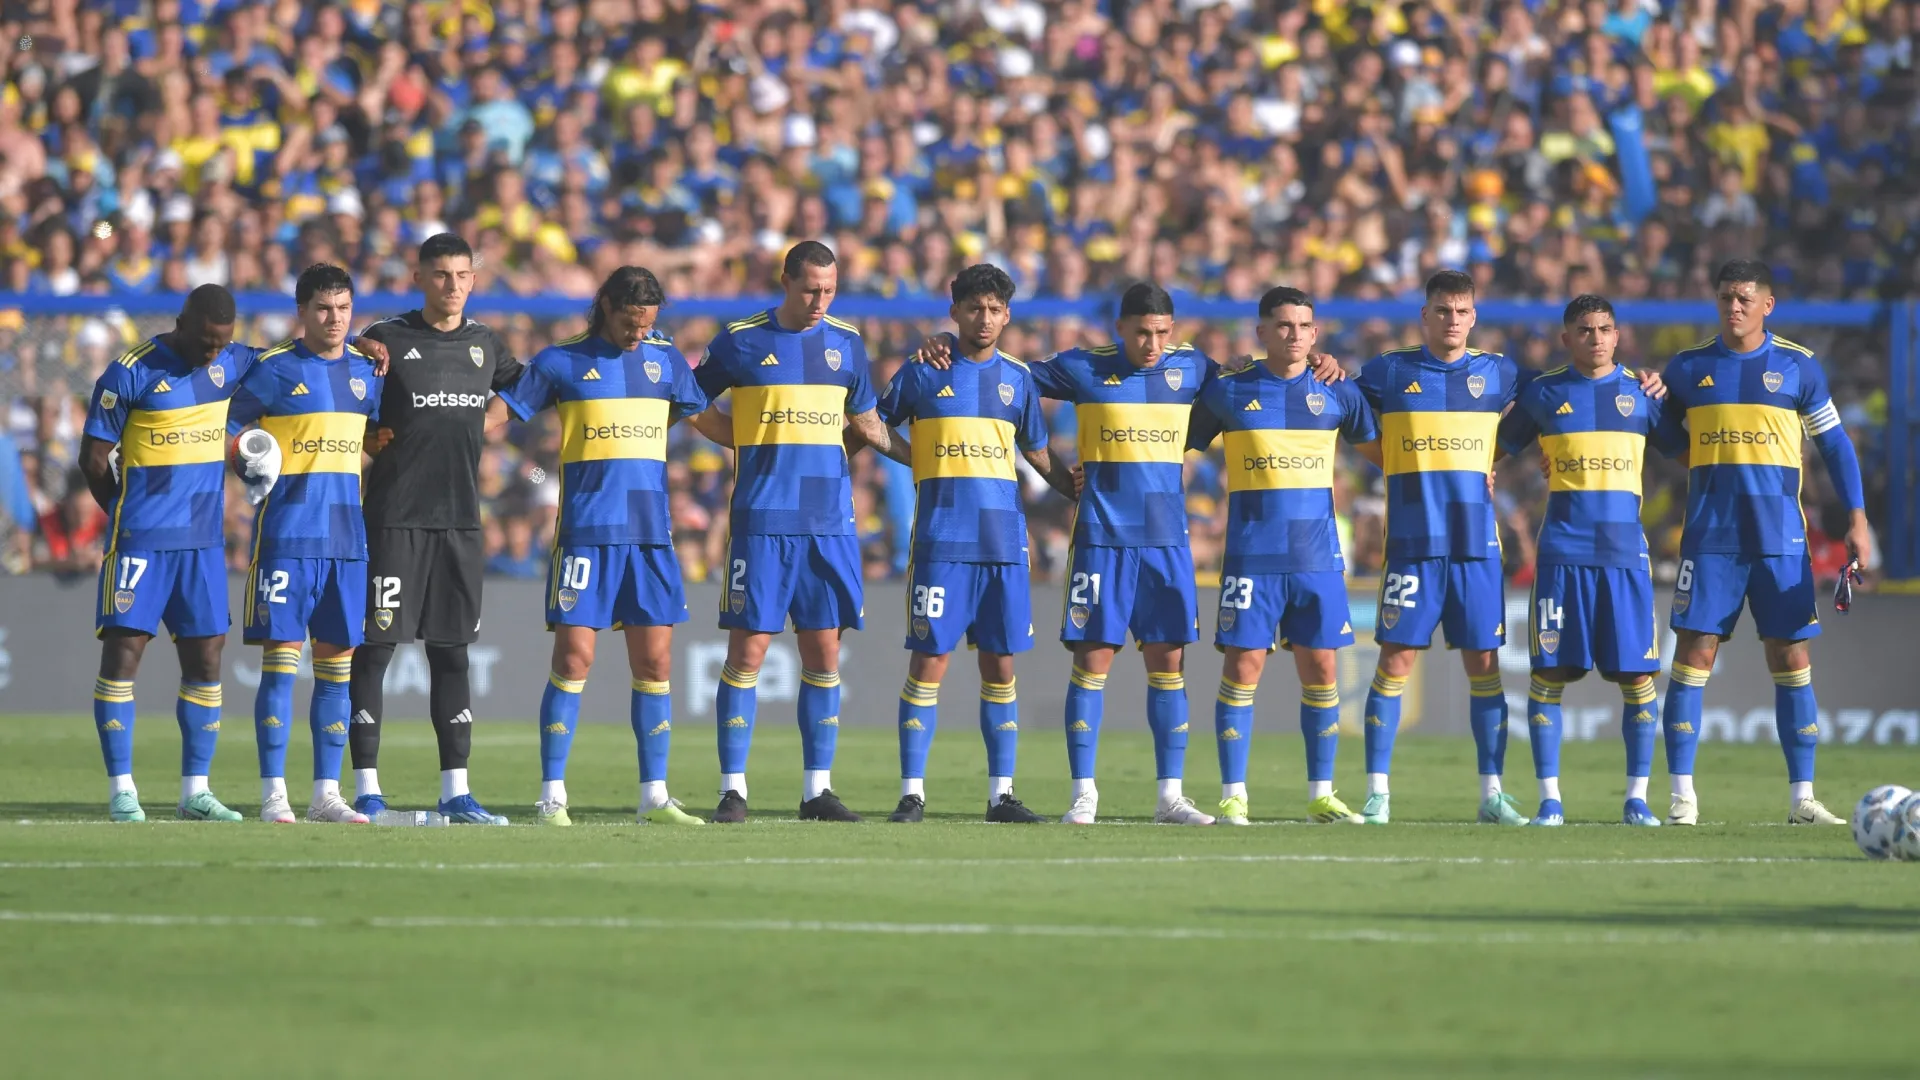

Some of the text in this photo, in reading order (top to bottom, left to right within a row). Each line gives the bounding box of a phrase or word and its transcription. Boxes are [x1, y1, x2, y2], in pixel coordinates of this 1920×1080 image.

[412, 390, 485, 408] betsson
[583, 422, 663, 440] betsson
[760, 407, 840, 427] betsson
[292, 436, 361, 454] betsson
[1100, 425, 1179, 443] betsson
[1401, 435, 1484, 452] betsson
[1700, 427, 1779, 446] betsson
[1243, 453, 1324, 471] betsson
[1555, 455, 1633, 473] betsson
[119, 556, 148, 590] 17
[259, 568, 289, 604] 42
[563, 555, 592, 590] 10
[730, 558, 748, 591] 2
[1070, 571, 1101, 605] 21
[1677, 559, 1694, 591] 6
[372, 576, 401, 608] 12
[913, 585, 945, 618] 36
[1221, 575, 1254, 610] 23
[1383, 572, 1420, 608] 22
[1538, 598, 1564, 630] 14
